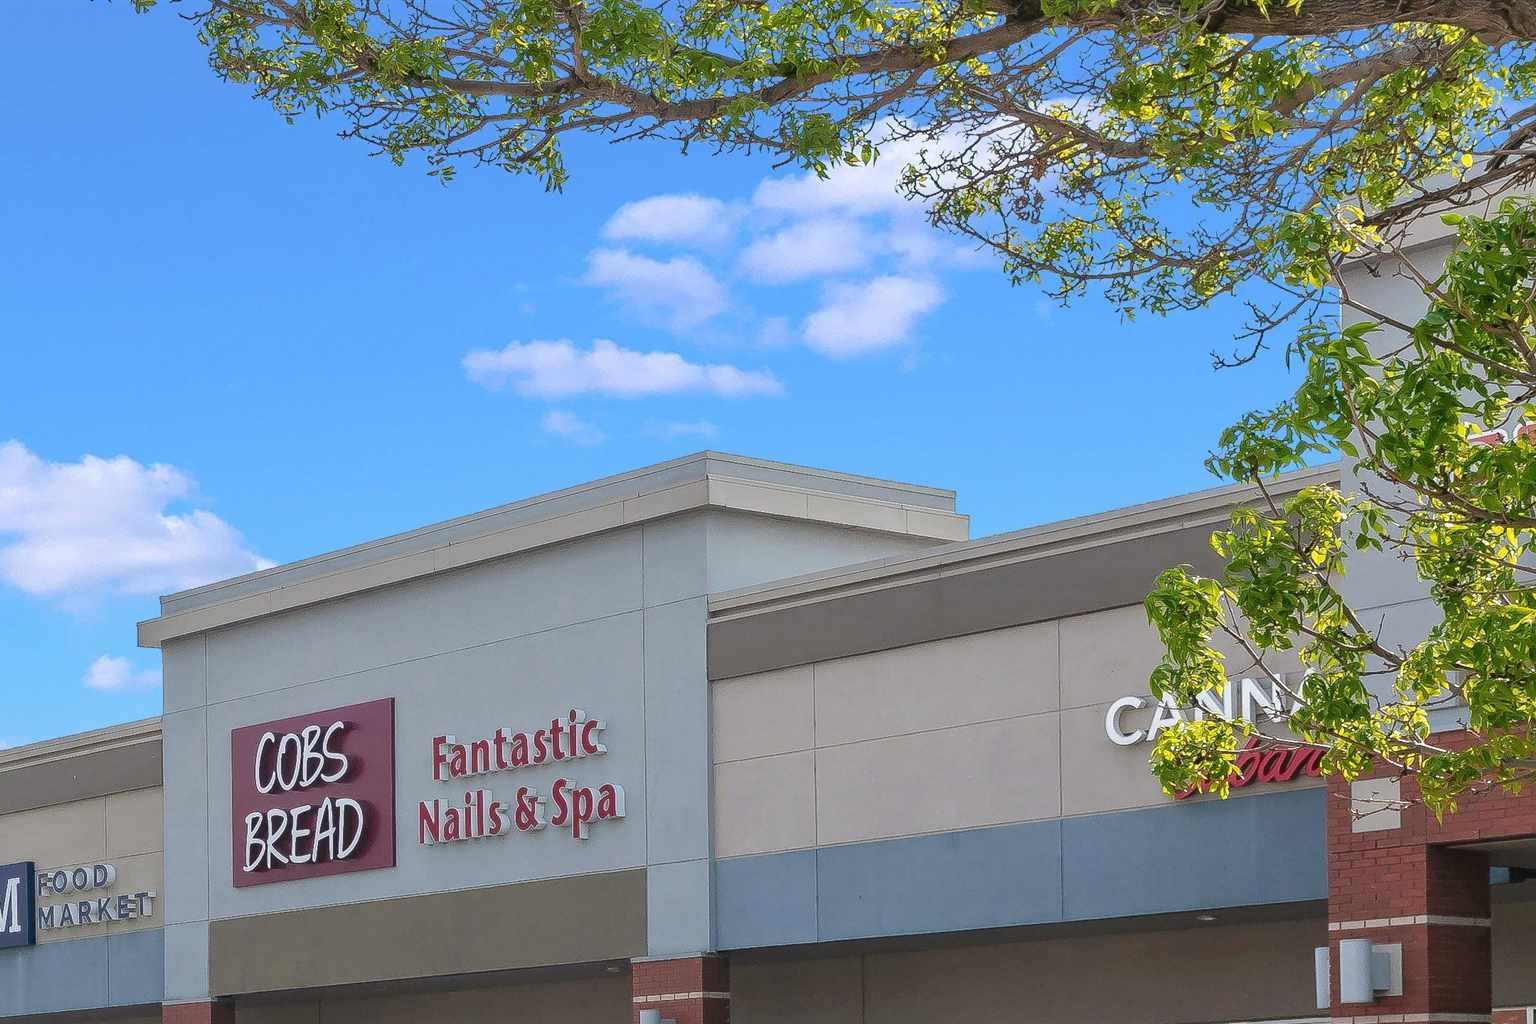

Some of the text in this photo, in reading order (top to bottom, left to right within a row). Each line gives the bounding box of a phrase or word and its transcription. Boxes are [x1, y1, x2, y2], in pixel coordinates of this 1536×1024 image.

[253, 720, 349, 795] COBS
[432, 709, 607, 783] Fantastic
[242, 797, 364, 872] BREAD
[418, 777, 625, 846] Nails & Spa
[38, 864, 115, 896] FOOD
[38, 890, 154, 930] MARKET
